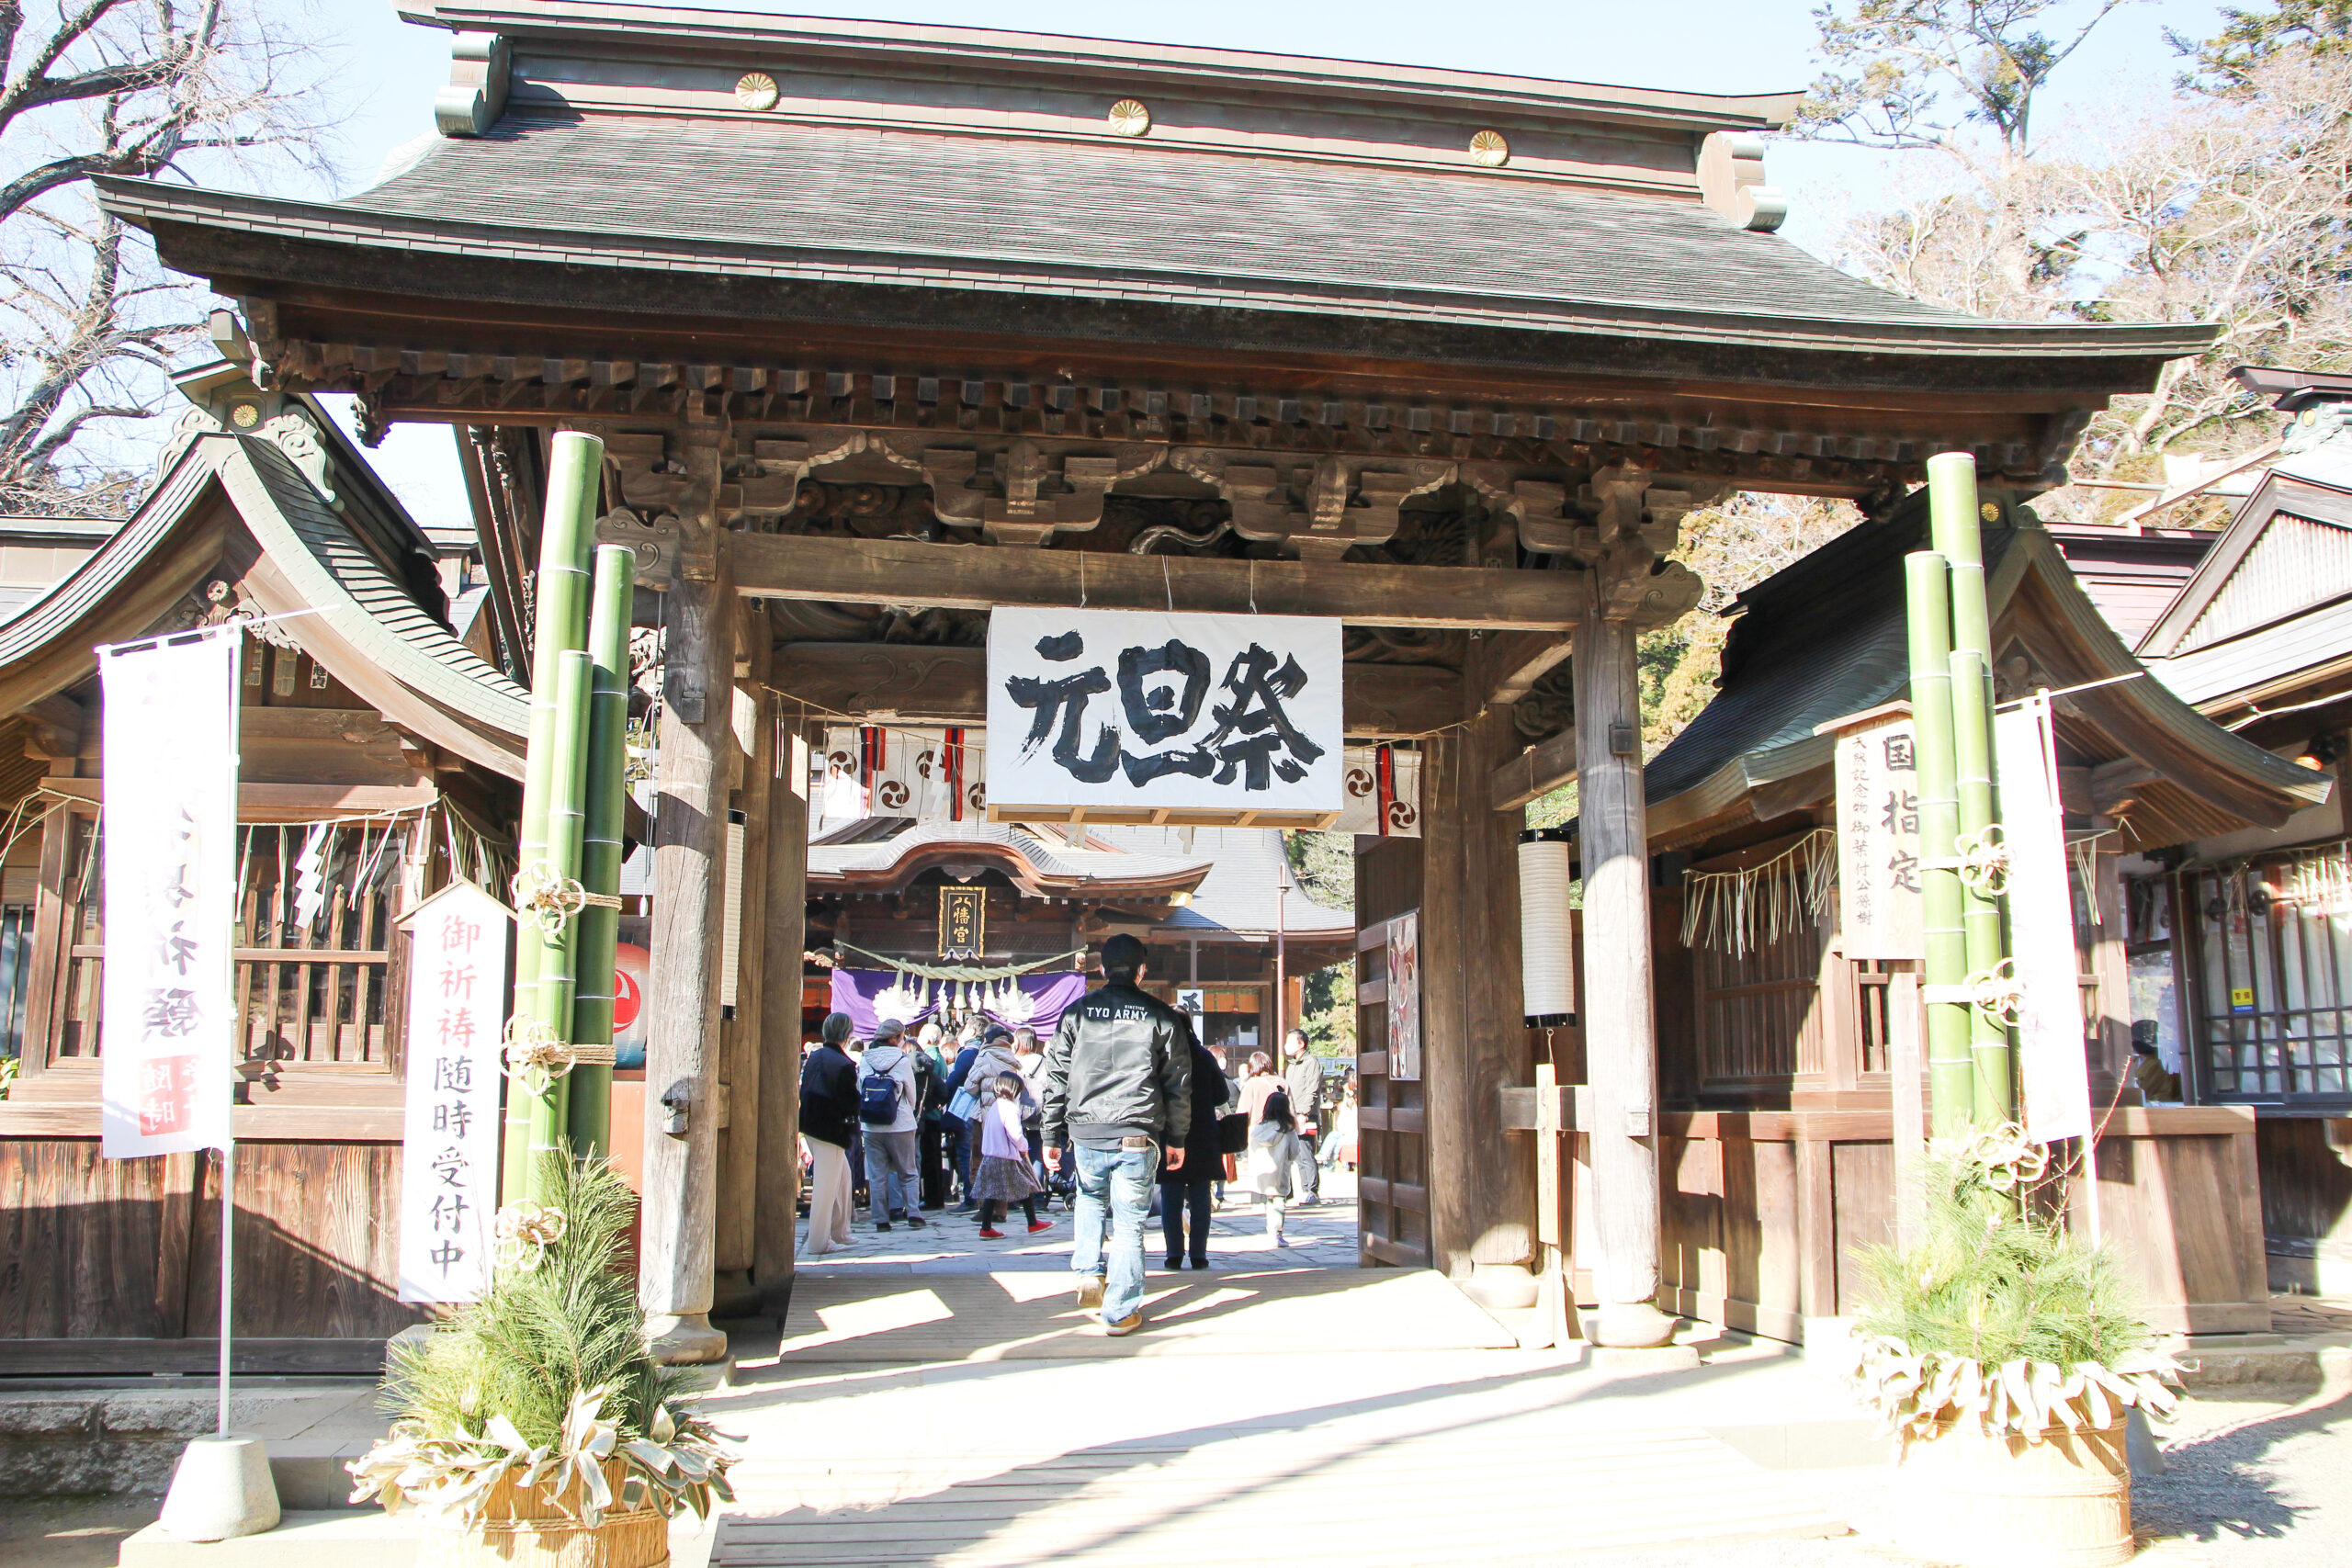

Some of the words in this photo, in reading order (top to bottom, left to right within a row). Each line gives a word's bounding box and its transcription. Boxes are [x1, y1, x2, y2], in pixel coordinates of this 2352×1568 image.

[1005, 629, 1326, 791] 元旦祭
[1882, 734, 1922, 894] 国指定
[952, 897, 972, 943] 八幡宮
[1087, 1007, 1110, 1018] TYO
[1114, 1009, 1148, 1021] ARMY
[430, 915, 481, 1280] 御祈祷随時受付中
